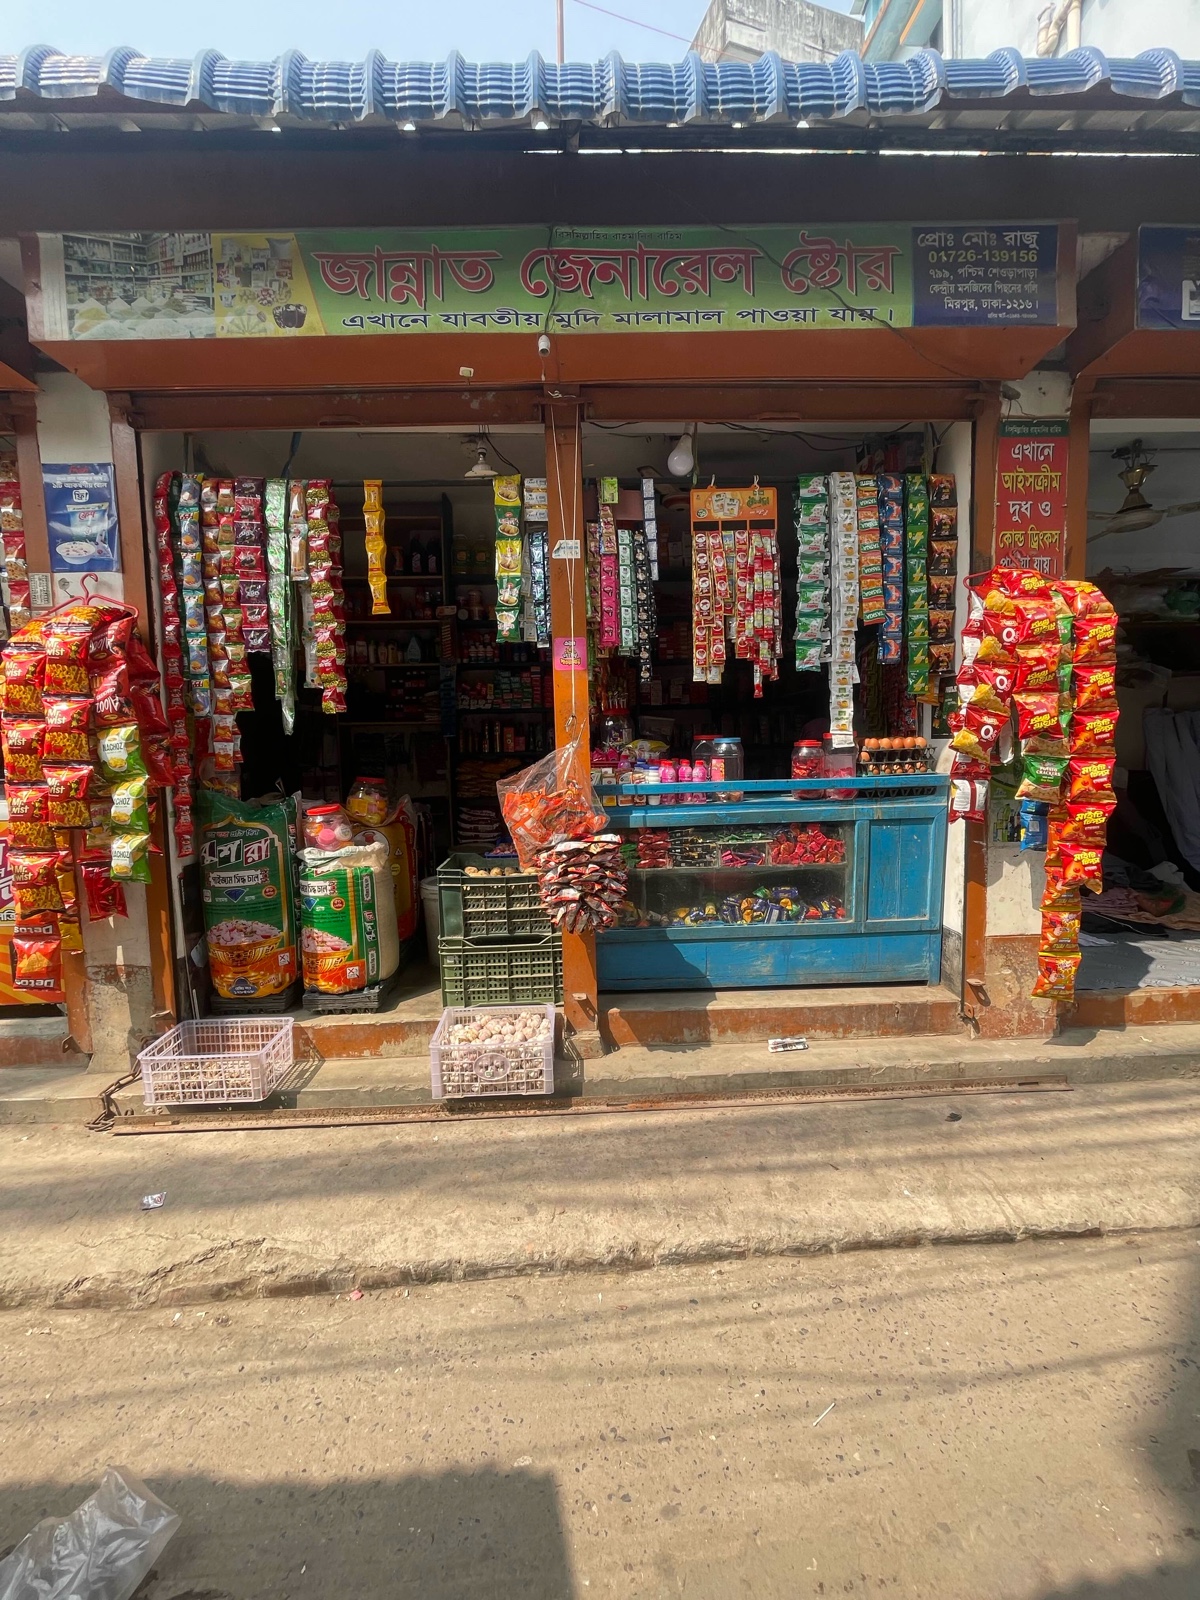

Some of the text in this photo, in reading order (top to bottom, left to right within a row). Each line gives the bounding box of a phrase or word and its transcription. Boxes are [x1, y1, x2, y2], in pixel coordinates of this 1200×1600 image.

[962, 230, 997, 247] মোঃ
[1003, 230, 1040, 250] রাজু
[928, 250, 1038, 263] 01726-139156
[310, 230, 903, 310] জান্নাত জেনারেল ষ্টোর
[957, 265, 985, 278] পশ্চিম
[957, 281, 992, 293] মসজিদের
[994, 281, 1021, 294] পিছনের
[342, 310, 432, 329] এখানে
[438, 306, 544, 328] যাবতীয়
[550, 308, 604, 331] মুদি
[612, 308, 725, 326] মালামাল
[735, 306, 821, 325] পাওয়া
[1011, 441, 1055, 462] এখানে
[1001, 464, 1062, 495] আইসক্রীম
[1008, 500, 1051, 523] দুধ ও
[999, 529, 1026, 549] কোল্ড
[1000, 557, 1031, 570] পায়া
